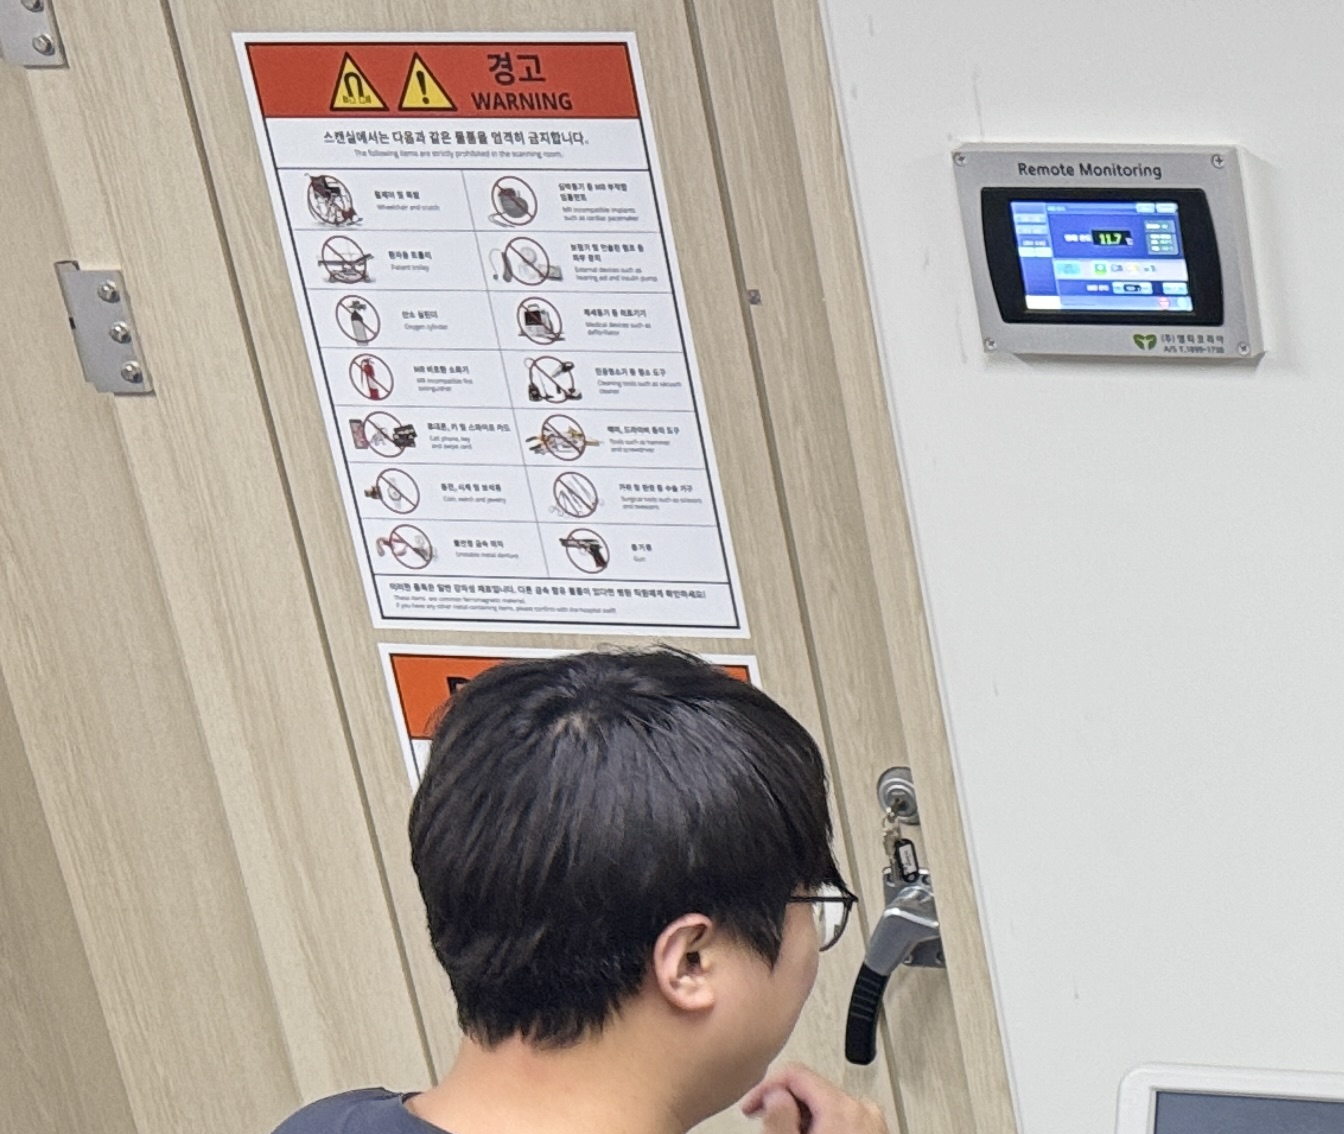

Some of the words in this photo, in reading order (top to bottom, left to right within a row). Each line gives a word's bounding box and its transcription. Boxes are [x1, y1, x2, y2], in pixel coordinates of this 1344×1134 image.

[487, 54, 546, 87] 경고
[471, 92, 573, 112] WARNING
[324, 130, 389, 145] 스캔실에서는
[392, 130, 426, 145] 다음과
[429, 131, 452, 145] 같은
[1018, 163, 1075, 177] Remote
[1080, 163, 1163, 180] Monitoring
